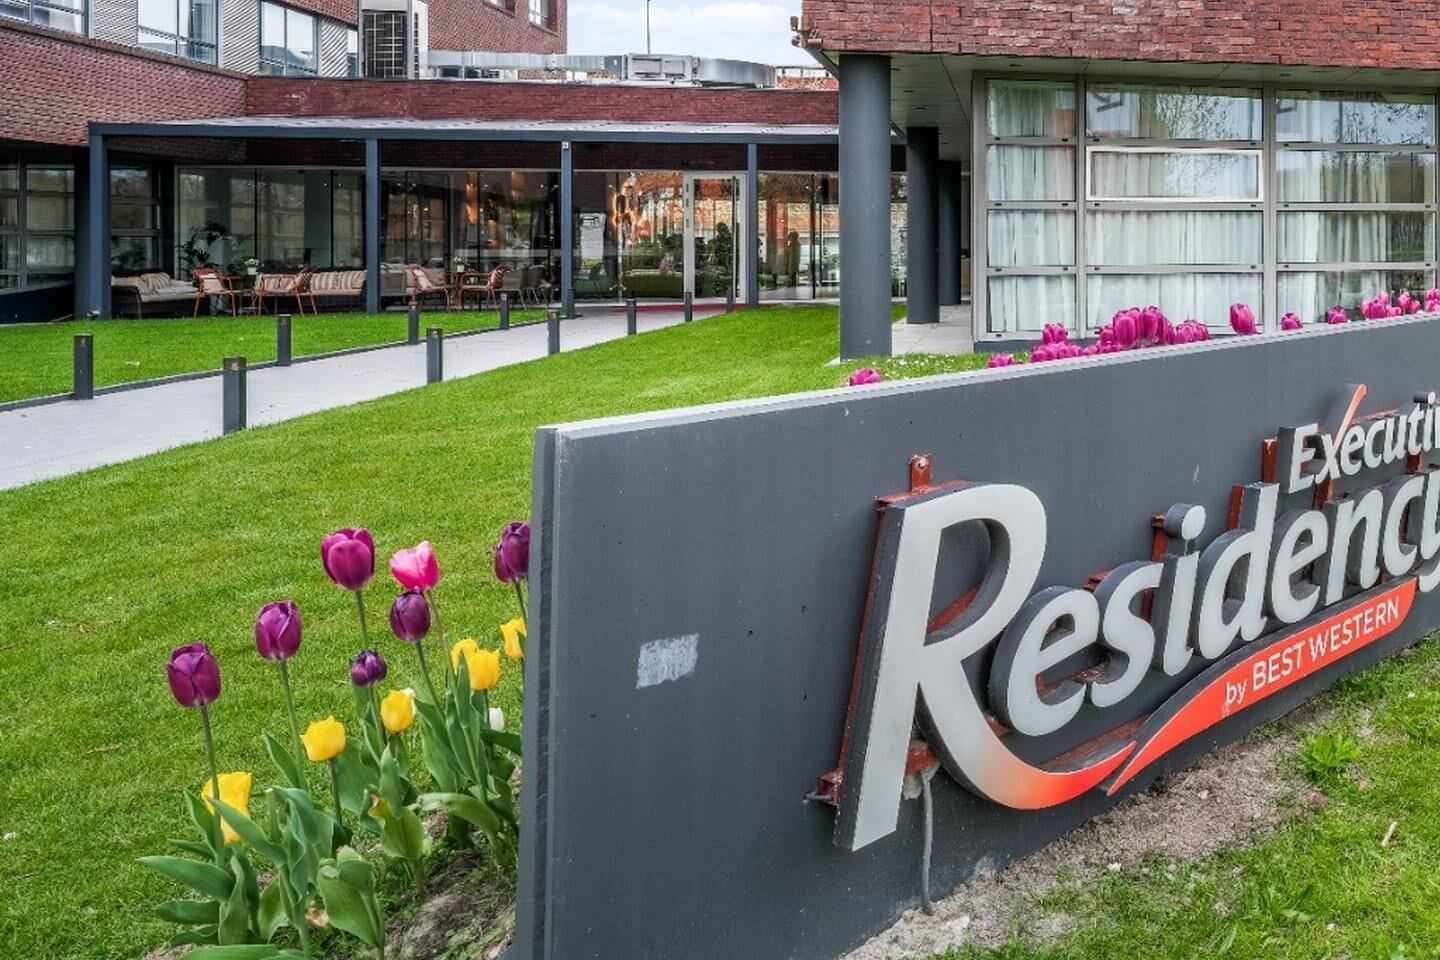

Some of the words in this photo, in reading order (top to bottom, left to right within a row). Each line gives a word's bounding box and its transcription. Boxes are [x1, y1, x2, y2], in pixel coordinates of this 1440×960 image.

[1225, 680, 1248, 705] by
[1252, 640, 1306, 692] BEST
[1308, 595, 1401, 662] WESTERN
